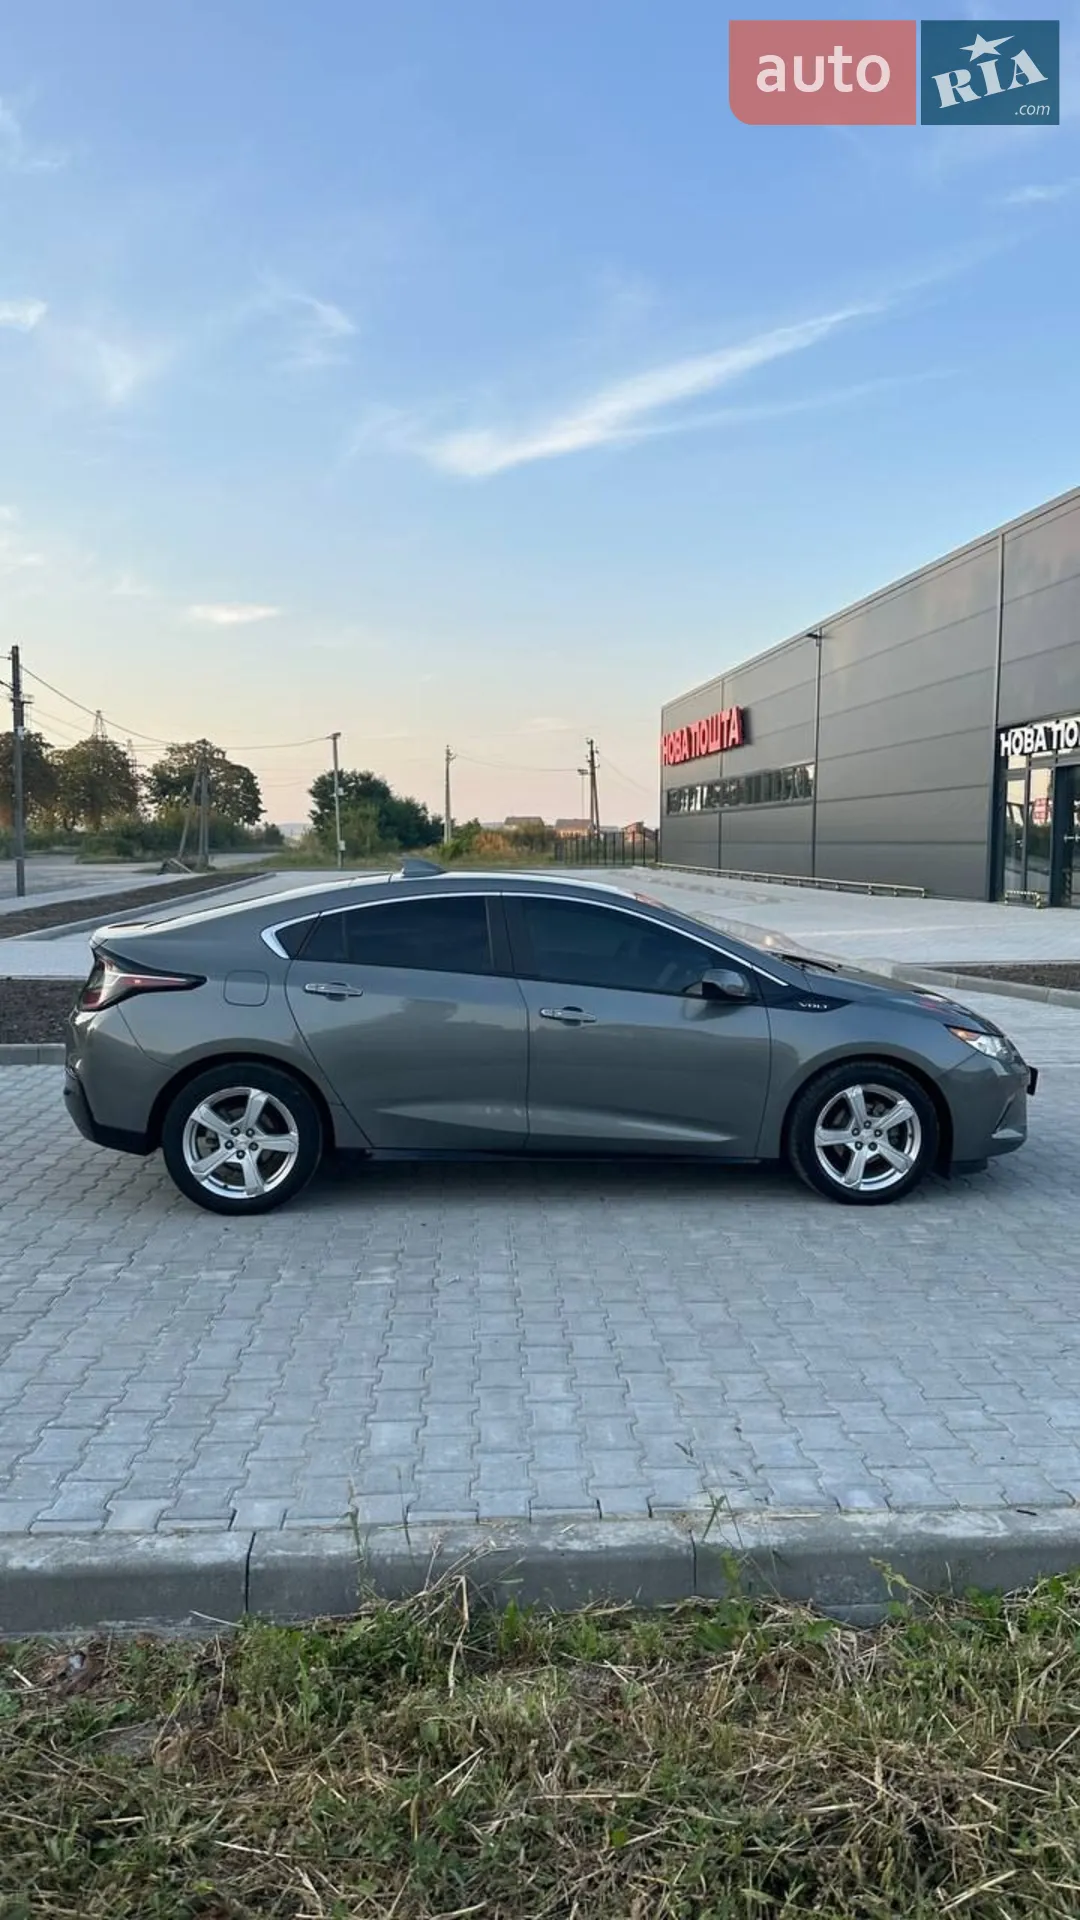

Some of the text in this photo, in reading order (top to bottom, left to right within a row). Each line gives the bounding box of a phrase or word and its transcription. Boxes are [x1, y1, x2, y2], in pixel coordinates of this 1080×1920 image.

[661, 704, 744, 766] НОВА ПОШТА
[1000, 718, 1080, 757] НОВА ПО
